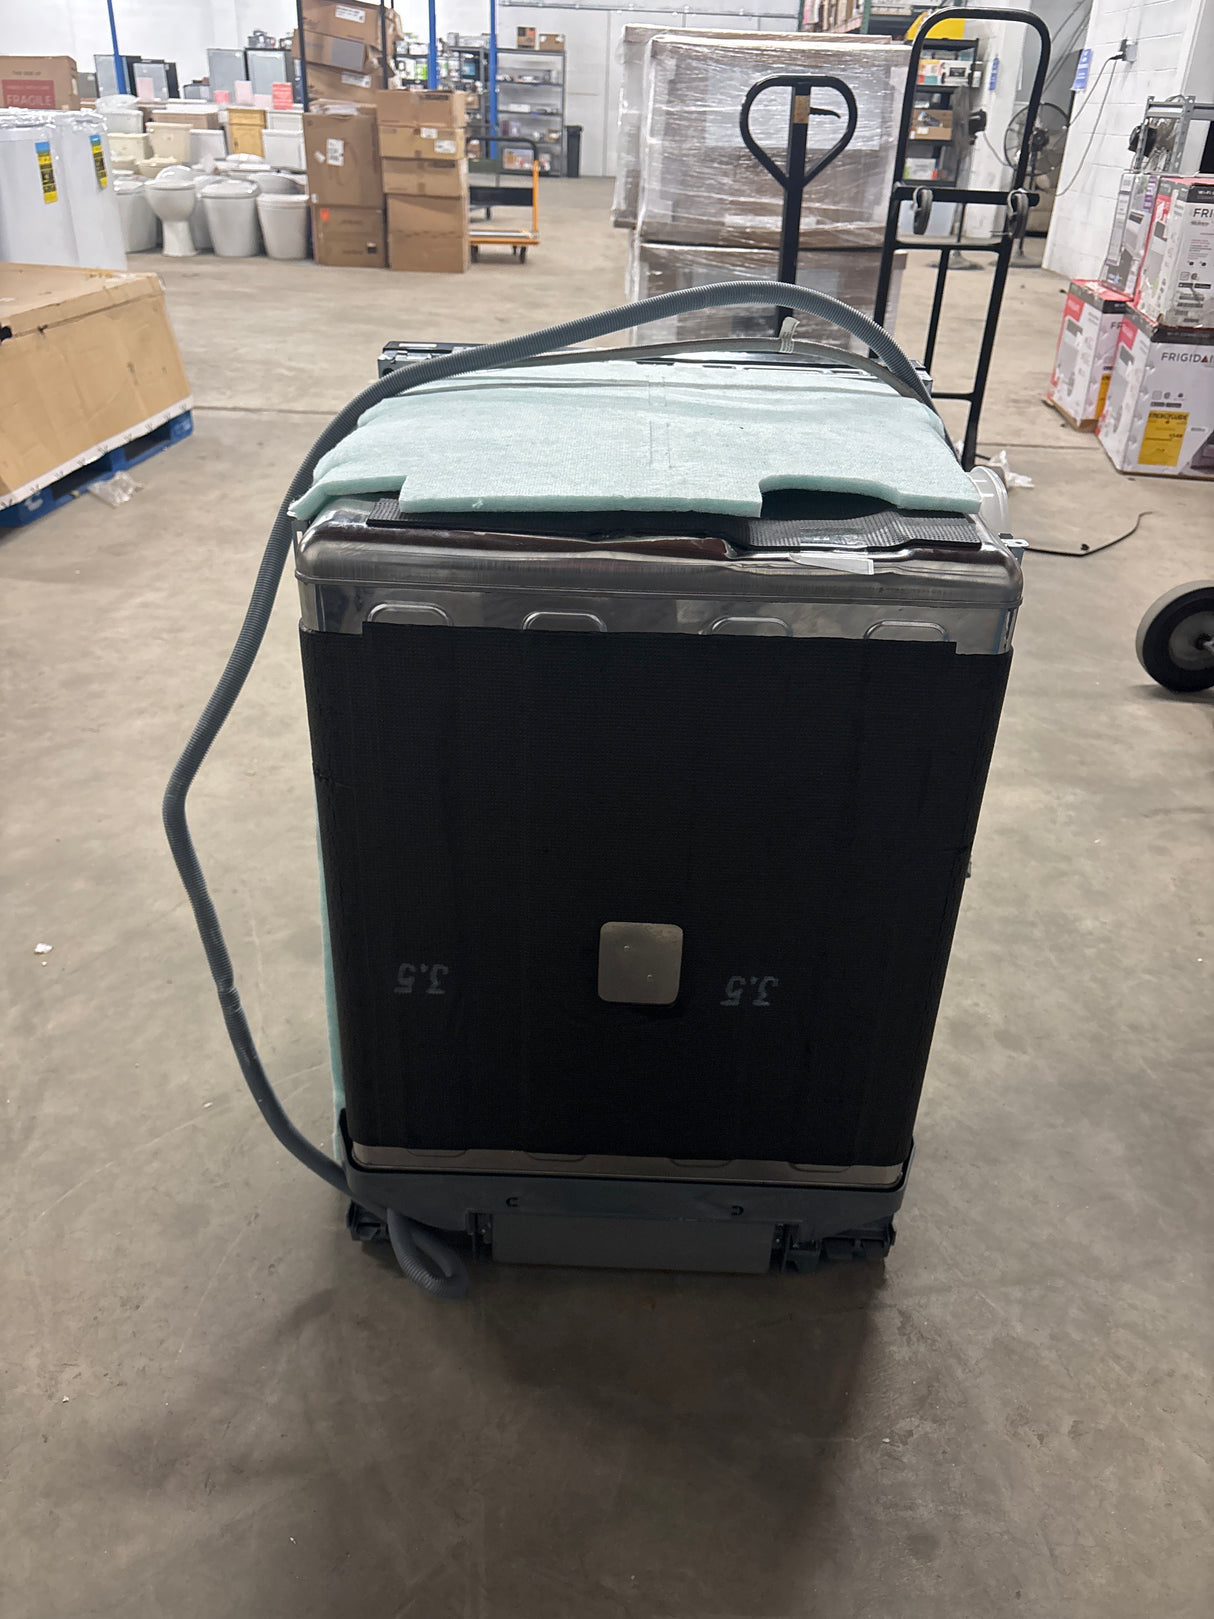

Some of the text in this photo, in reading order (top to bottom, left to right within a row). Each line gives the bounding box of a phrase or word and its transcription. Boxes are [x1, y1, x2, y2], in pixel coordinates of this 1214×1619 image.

[6, 94, 53, 106] FRAGILE
[1192, 207, 1214, 218] FRI
[393, 962, 449, 994] 3.5
[720, 975, 779, 1007] 3.5
